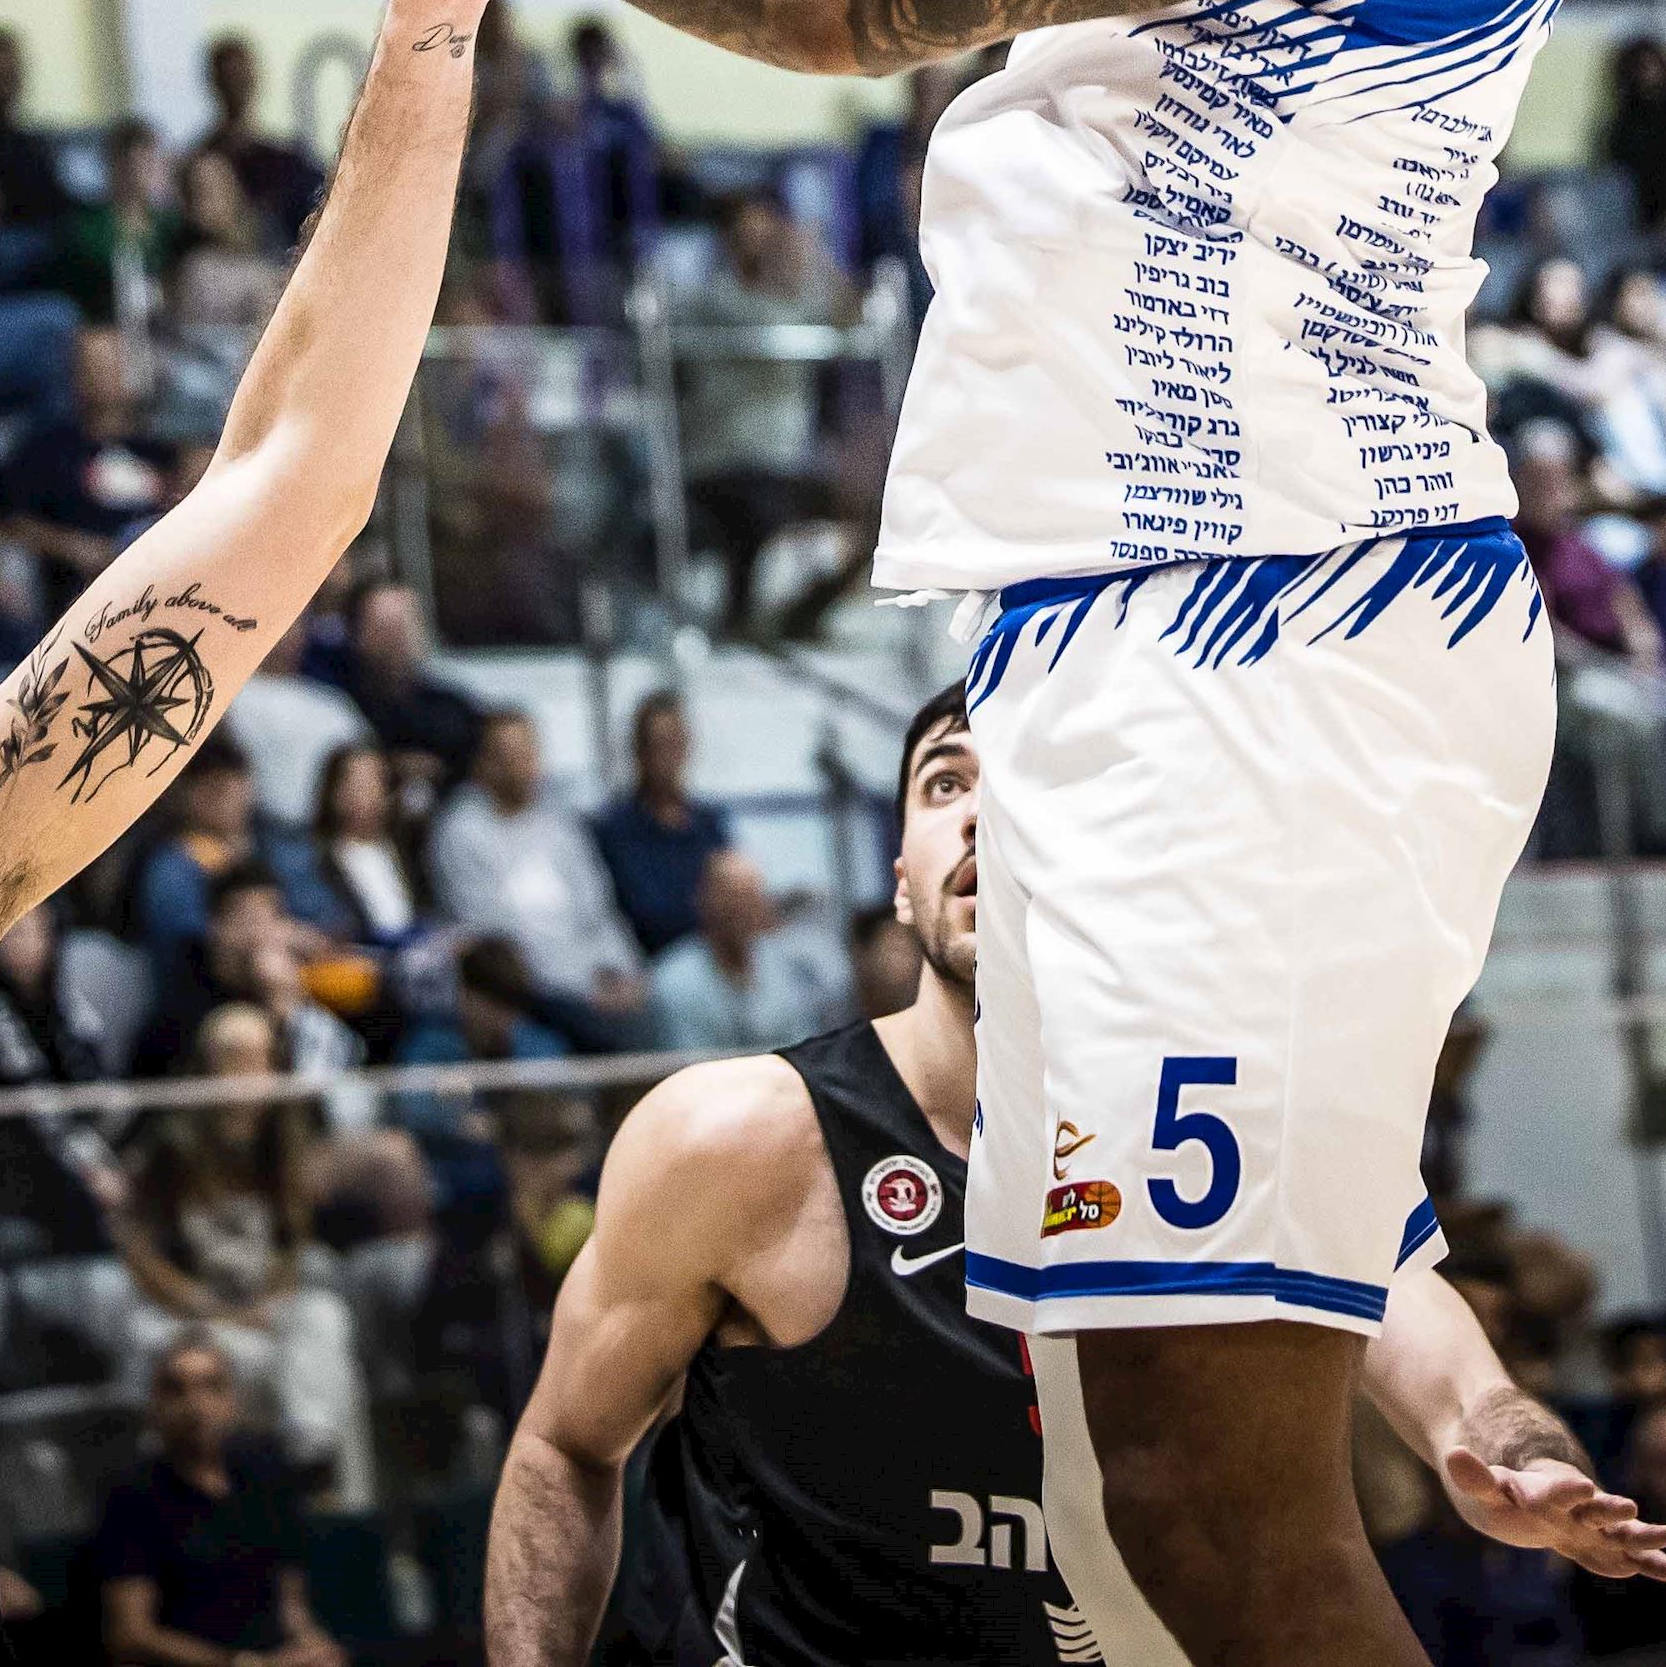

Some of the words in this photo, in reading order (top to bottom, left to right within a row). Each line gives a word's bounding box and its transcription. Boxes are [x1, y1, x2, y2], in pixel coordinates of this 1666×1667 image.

[1155, 93, 1210, 133] גורדון
[1233, 102, 1273, 139] מאיר
[1213, 125, 1256, 158] לארי
[1175, 140, 1239, 181] עמיקם
[1144, 233, 1189, 257] יצקן
[1193, 243, 1237, 266] יריב
[1133, 261, 1191, 289] גריפין
[1196, 275, 1230, 298] בוב
[1124, 288, 1197, 319] בארמור
[1113, 313, 1166, 345] קילינג
[1169, 326, 1233, 353] הרולד
[1124, 344, 1175, 370] ליובין
[1179, 357, 1232, 385] ליאור
[1151, 378, 1197, 402] מאיו
[1207, 418, 1241, 437] גרג
[1341, 414, 1407, 438] קצורין
[1359, 443, 1414, 469] גרשון
[1416, 441, 1451, 460] פיני
[1210, 487, 1243, 510] גילי
[1374, 476, 1411, 501] כהן
[1122, 511, 1188, 535] פיגארו
[1434, 502, 1460, 522] דני
[1193, 519, 1243, 545] קווין
[1110, 541, 1168, 562] ספנסר
[85, 584, 157, 643] Family
[165, 583, 223, 614] above
[1146, 1056, 1242, 1230] 5
[1079, 1200, 1100, 1220] סל
